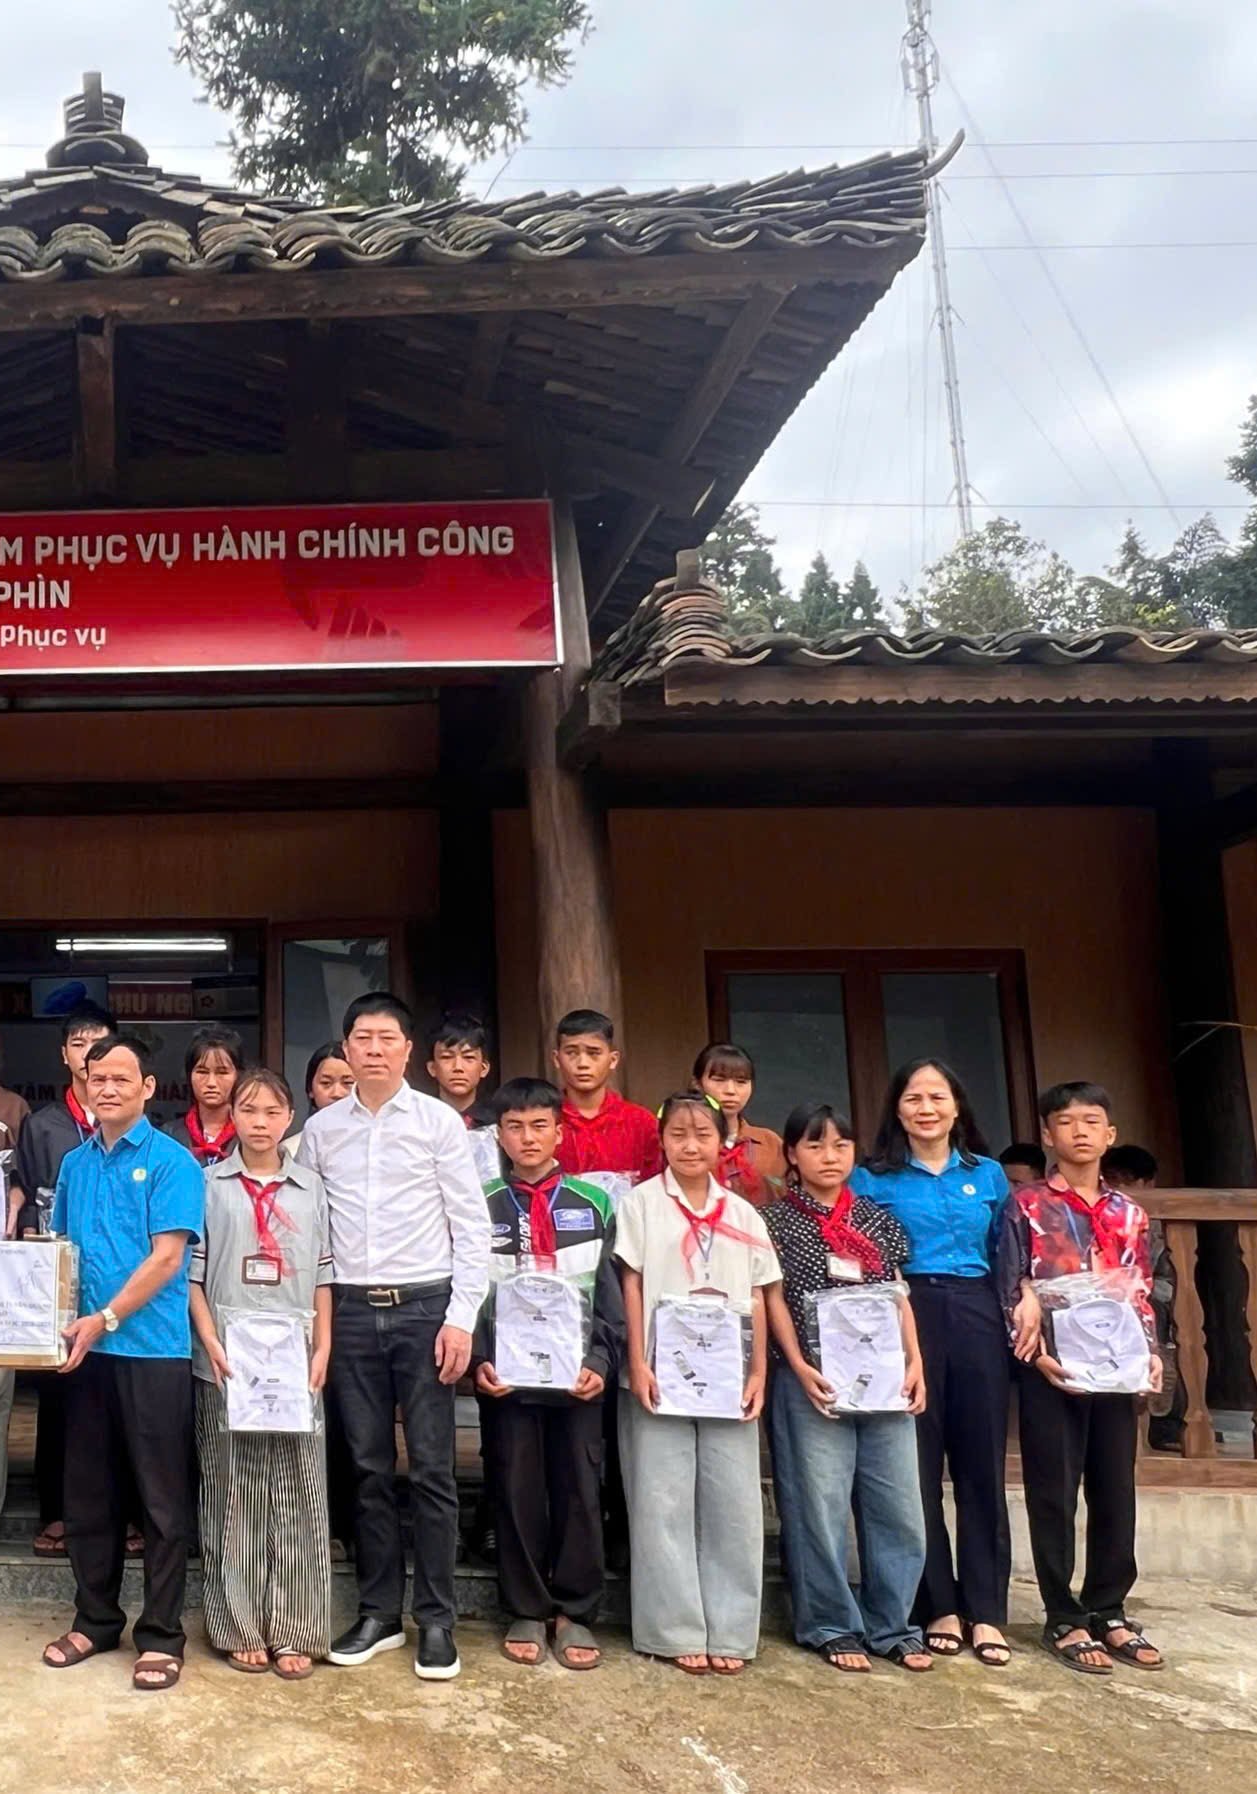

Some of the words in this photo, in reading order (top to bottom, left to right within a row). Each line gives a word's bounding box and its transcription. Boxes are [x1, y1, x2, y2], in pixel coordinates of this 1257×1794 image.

[34, 534, 128, 571] PHỤC
[135, 532, 181, 569] VỤ
[193, 524, 286, 561] HÀNH
[297, 521, 406, 558] CHÍNH
[417, 519, 515, 557] CÔNG
[0, 625, 67, 651] Phục
[74, 627, 107, 651] vụ
